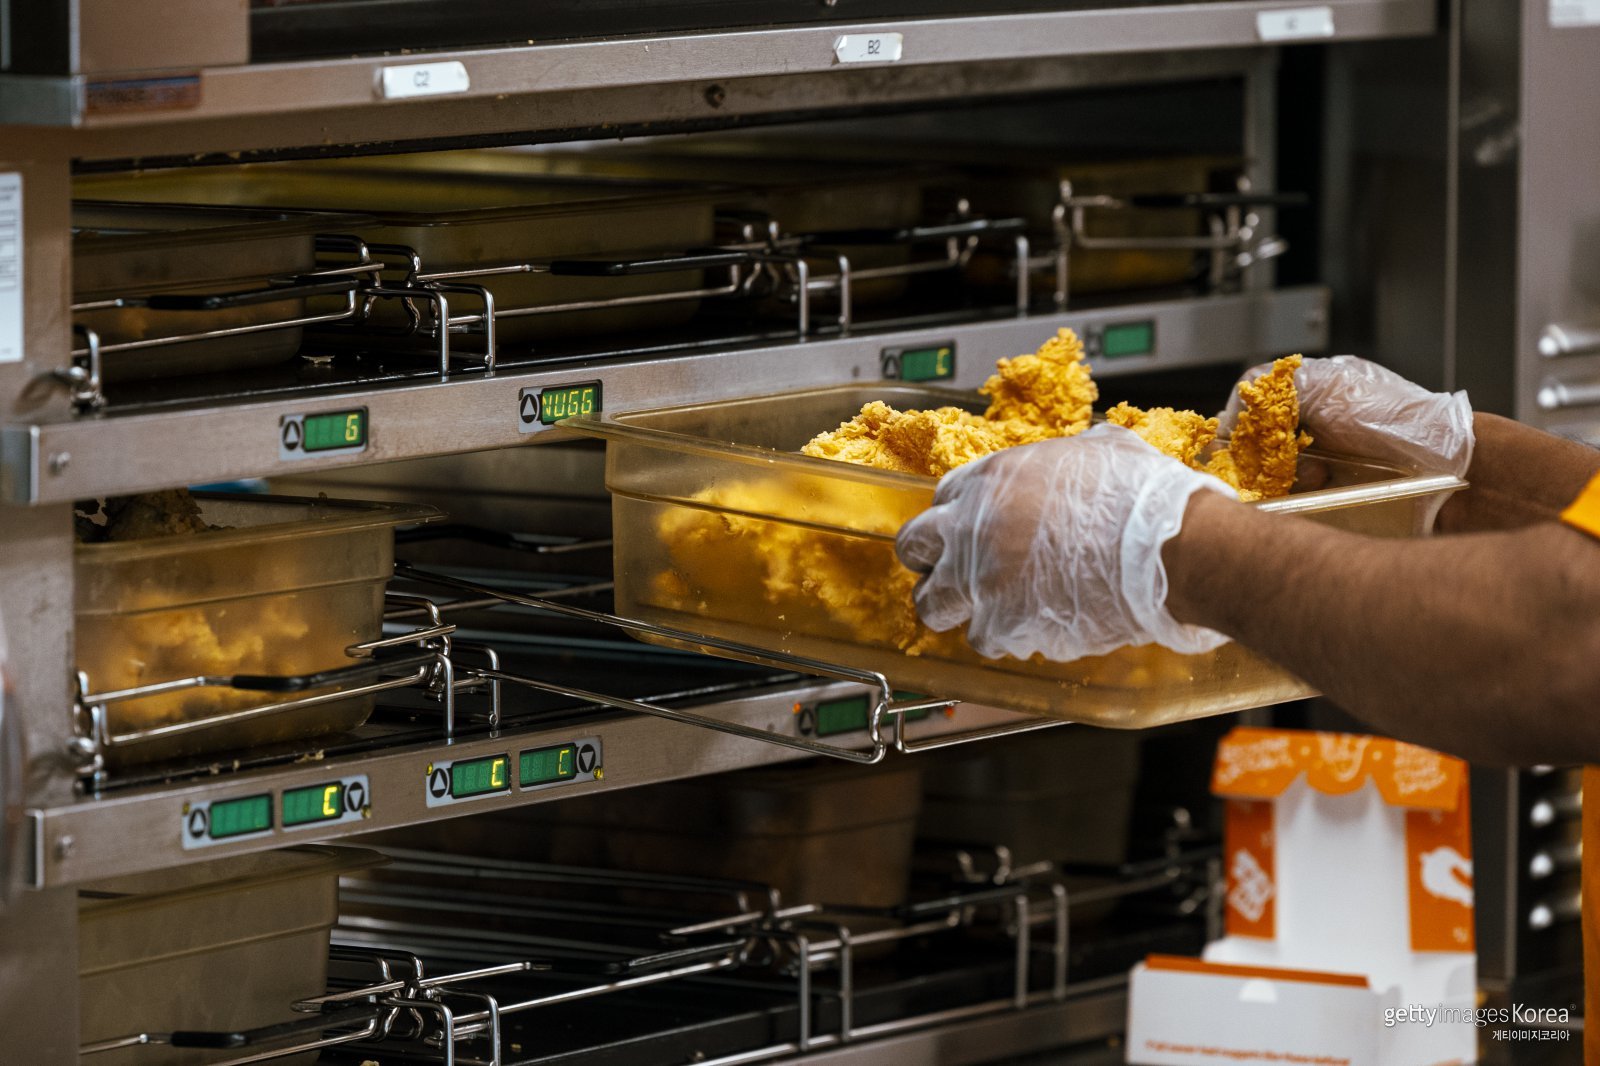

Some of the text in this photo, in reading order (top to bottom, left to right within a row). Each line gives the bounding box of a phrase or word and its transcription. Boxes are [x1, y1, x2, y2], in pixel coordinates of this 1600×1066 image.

[867, 39, 881, 55] B2
[413, 68, 430, 87] C2
[542, 388, 595, 418] NUGG
[490, 757, 504, 787] C
[322, 784, 339, 816] C
